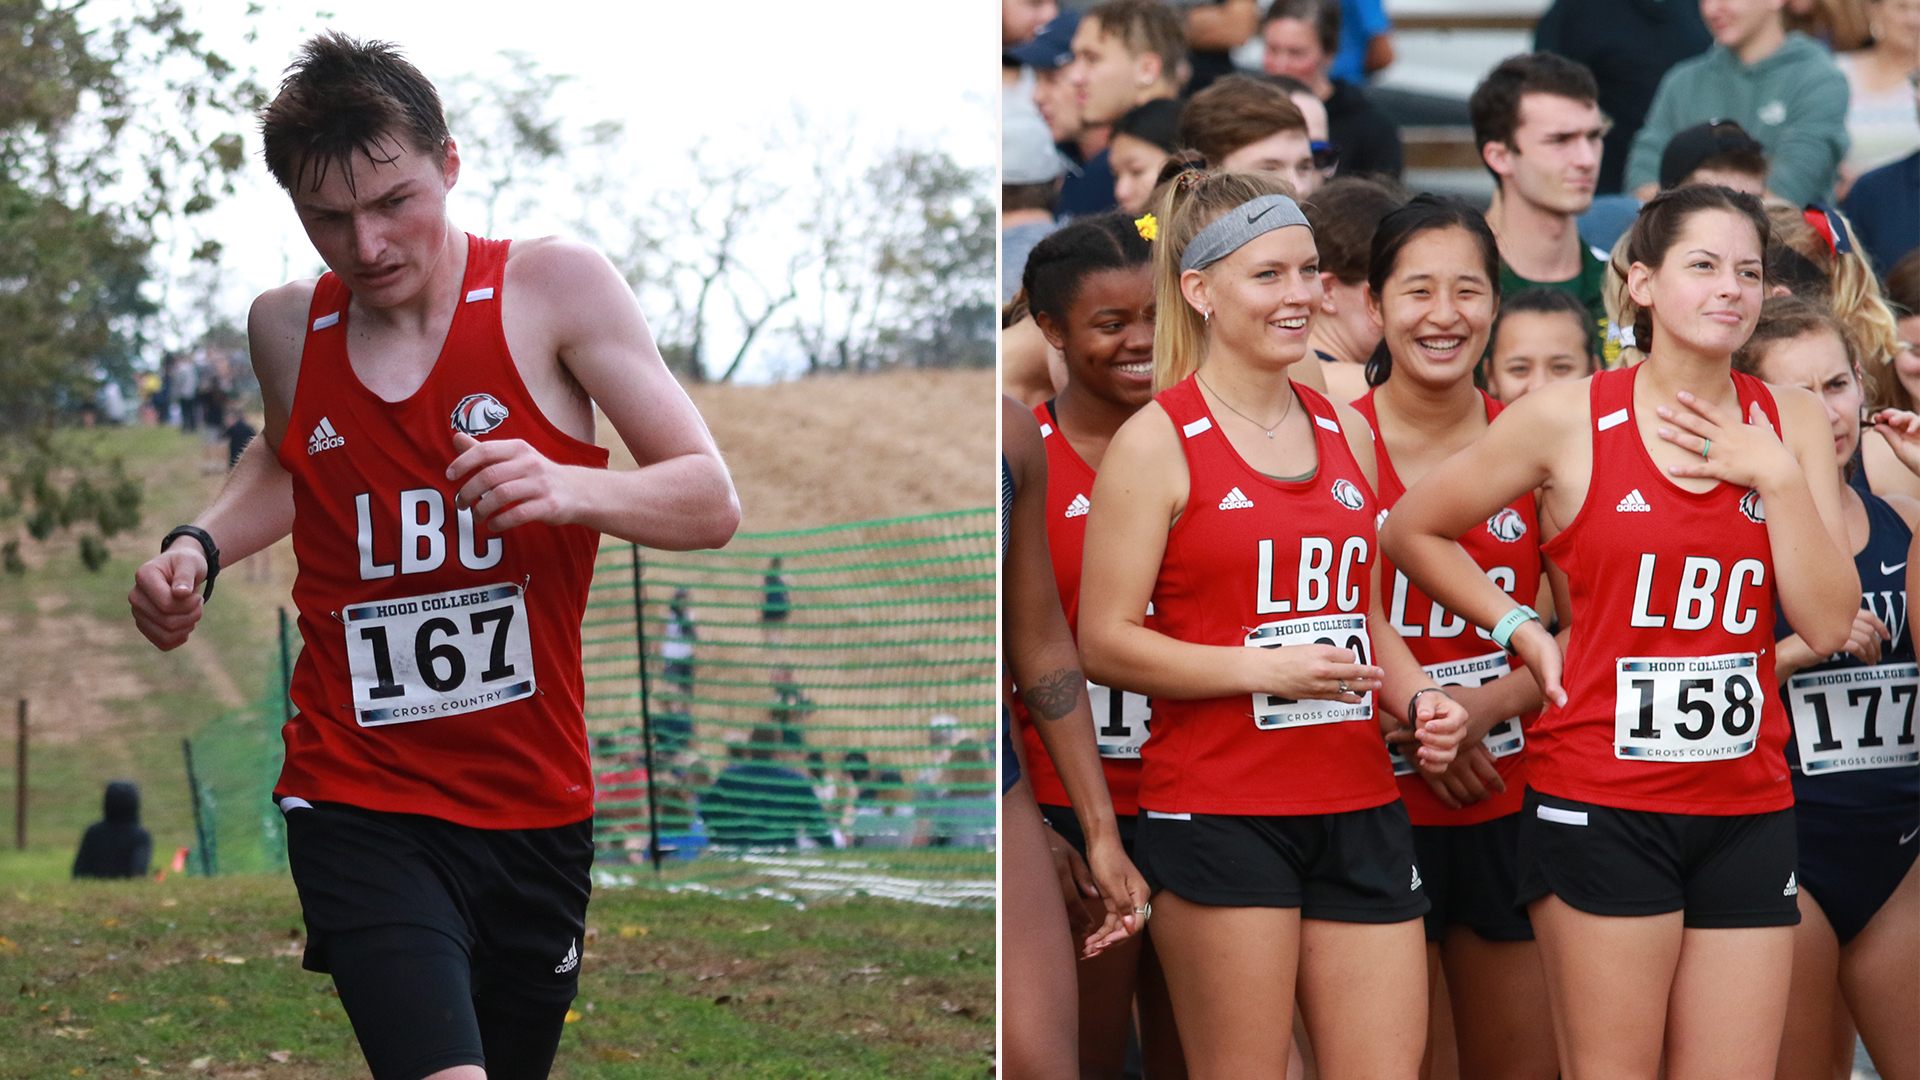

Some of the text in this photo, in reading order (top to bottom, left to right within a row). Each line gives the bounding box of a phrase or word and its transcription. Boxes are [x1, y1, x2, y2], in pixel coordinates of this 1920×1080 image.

[307, 435, 345, 456] adidas
[1065, 505, 1090, 518] adid
[1219, 499, 1254, 511] adidas
[1616, 501, 1651, 512] adidas
[355, 488, 503, 581] LBC
[1256, 535, 1368, 615] LBC
[1630, 553, 1766, 635] LBC
[376, 591, 490, 618] HOOD COLLEGE
[1275, 619, 1351, 637] HOOD COLLEGE
[360, 604, 515, 700] 167
[1437, 660, 1492, 679] COLLEGE
[1648, 658, 1736, 672] HOOD COLLEGE
[1817, 668, 1905, 686] HOOD COLLEGE
[392, 690, 502, 718] CROSS COUNTRY
[1629, 674, 1755, 741] 158
[1287, 708, 1363, 722] CROSS COUNTRY
[1803, 684, 1919, 753] 177
[1117, 746, 1141, 754] CRO
[1647, 745, 1738, 757] CROSS COUNTRY
[1833, 754, 1909, 767] CROSS COUNTRY
[555, 956, 579, 974] adidas
